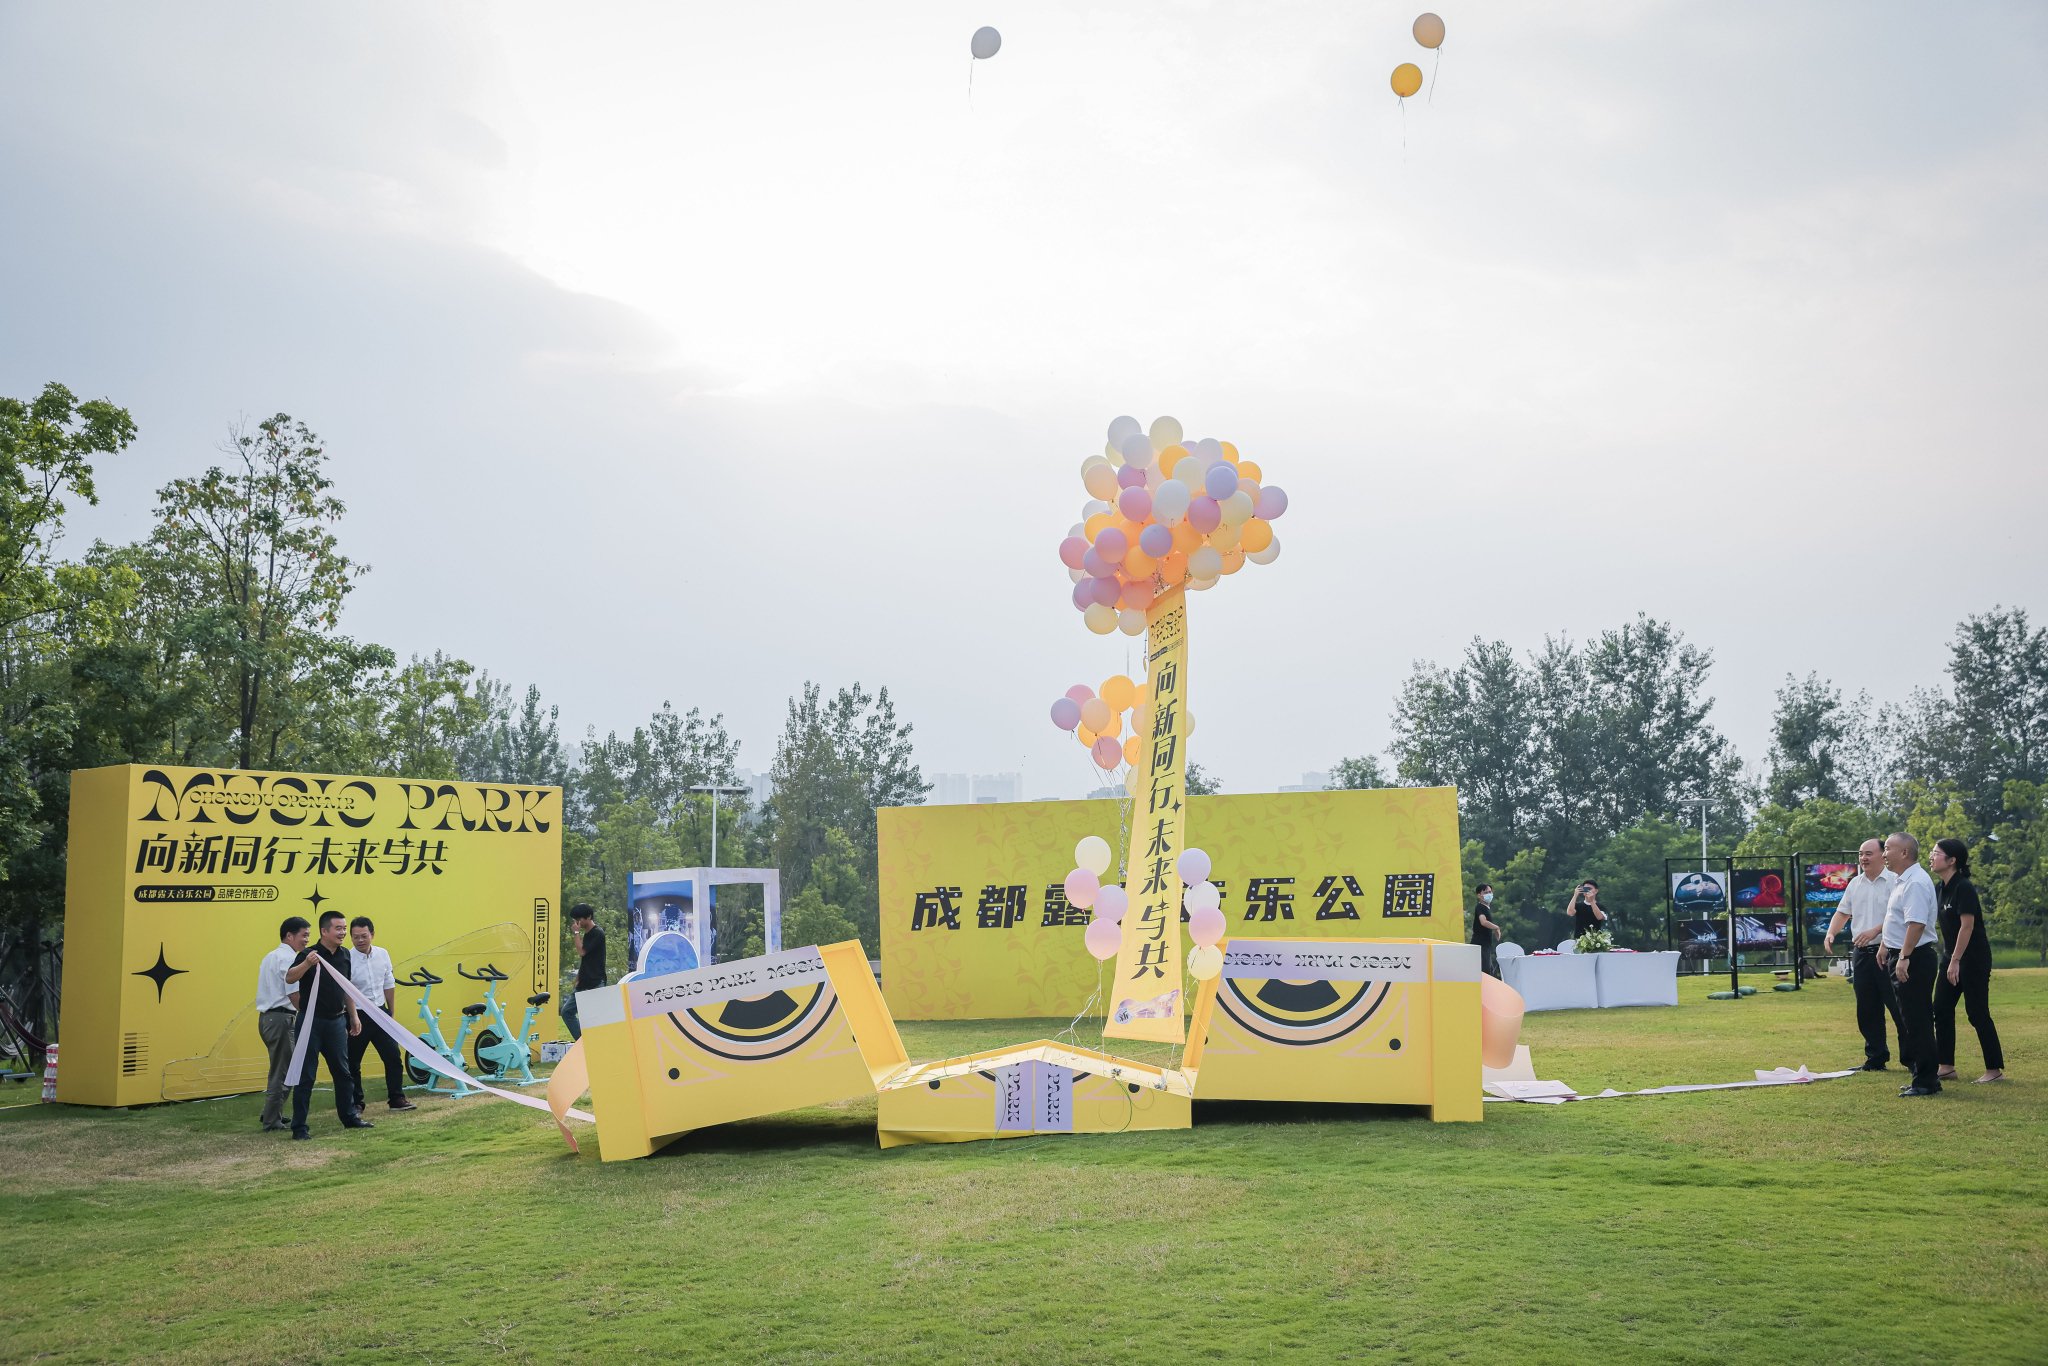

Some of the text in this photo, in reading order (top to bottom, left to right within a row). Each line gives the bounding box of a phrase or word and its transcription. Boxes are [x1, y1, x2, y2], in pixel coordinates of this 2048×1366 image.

[138, 770, 551, 833] MUSIC PARK
[189, 790, 274, 807] CHENGDU
[1131, 661, 1178, 980] 向新同行未来与共
[135, 830, 449, 875] 向新同行未来与共
[217, 888, 274, 899] 品牌合作推介会
[911, 873, 1435, 931] 成都露乐公园
[1295, 954, 1344, 968] PARK
[644, 981, 703, 1004] MUSIC
[708, 971, 757, 992] PARK
[1008, 1072, 1020, 1122] PARK
[1047, 1073, 1060, 1123] PARK
